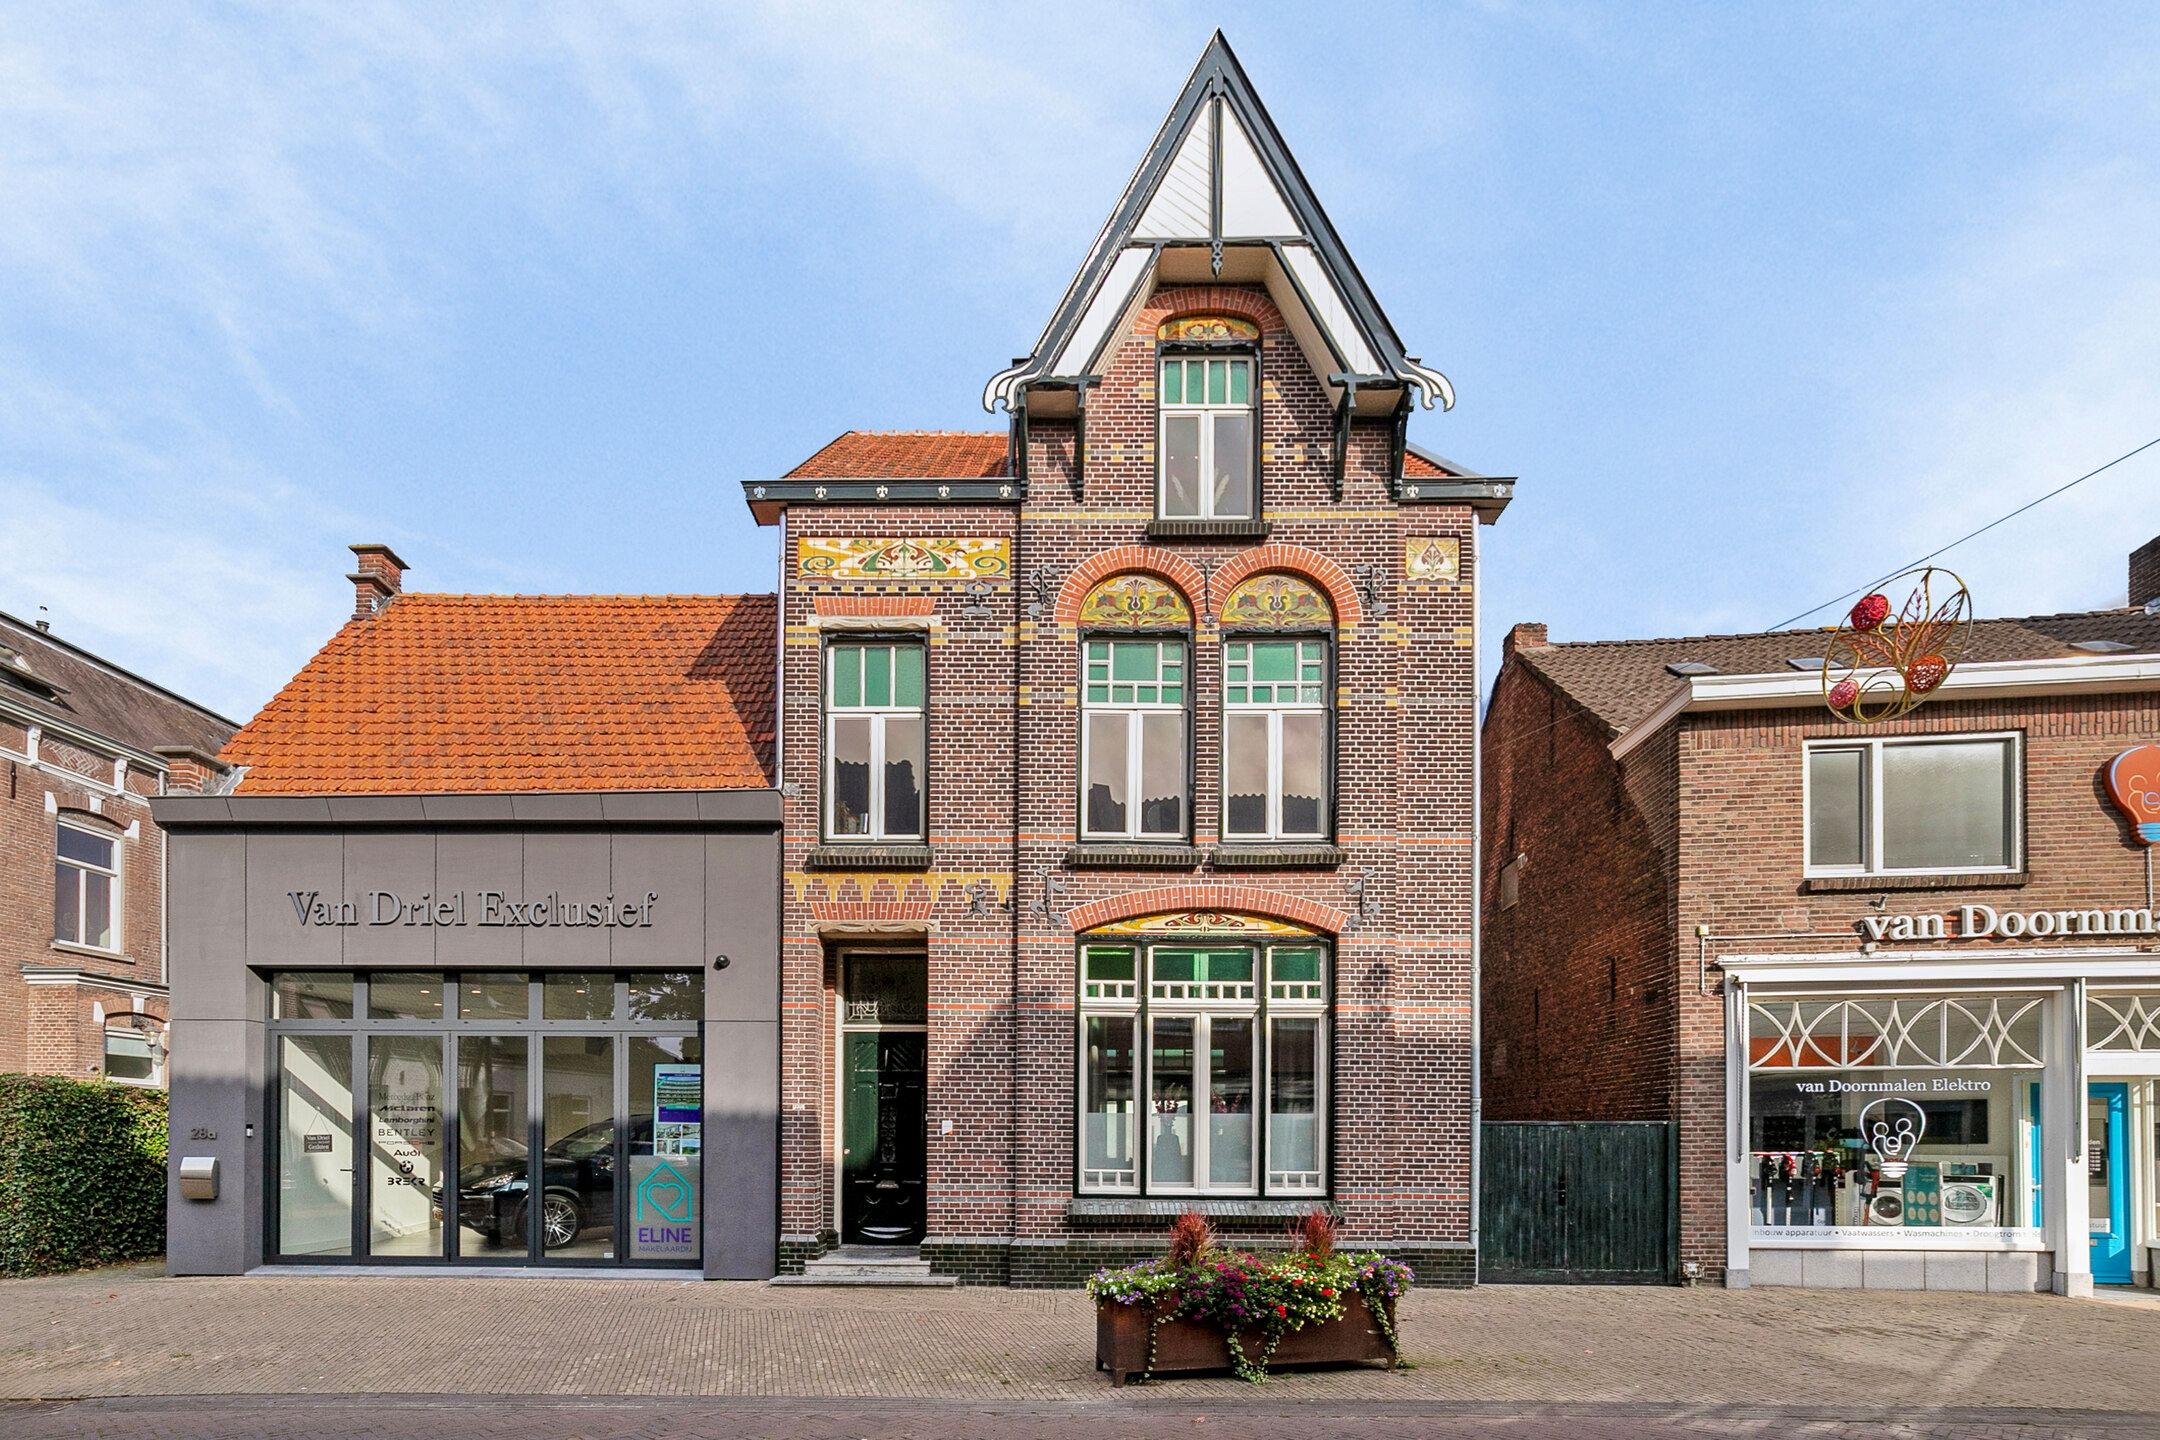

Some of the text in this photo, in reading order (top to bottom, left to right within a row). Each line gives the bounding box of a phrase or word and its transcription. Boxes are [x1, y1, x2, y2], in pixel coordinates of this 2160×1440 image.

[287, 891, 659, 927] Van Driel Exclusief
[1863, 903, 2160, 941] van Doornm
[1796, 1078, 1991, 1093] van Doornmalen Elektro
[191, 1128, 218, 1140] 28a
[638, 1227, 692, 1243] ELINE
